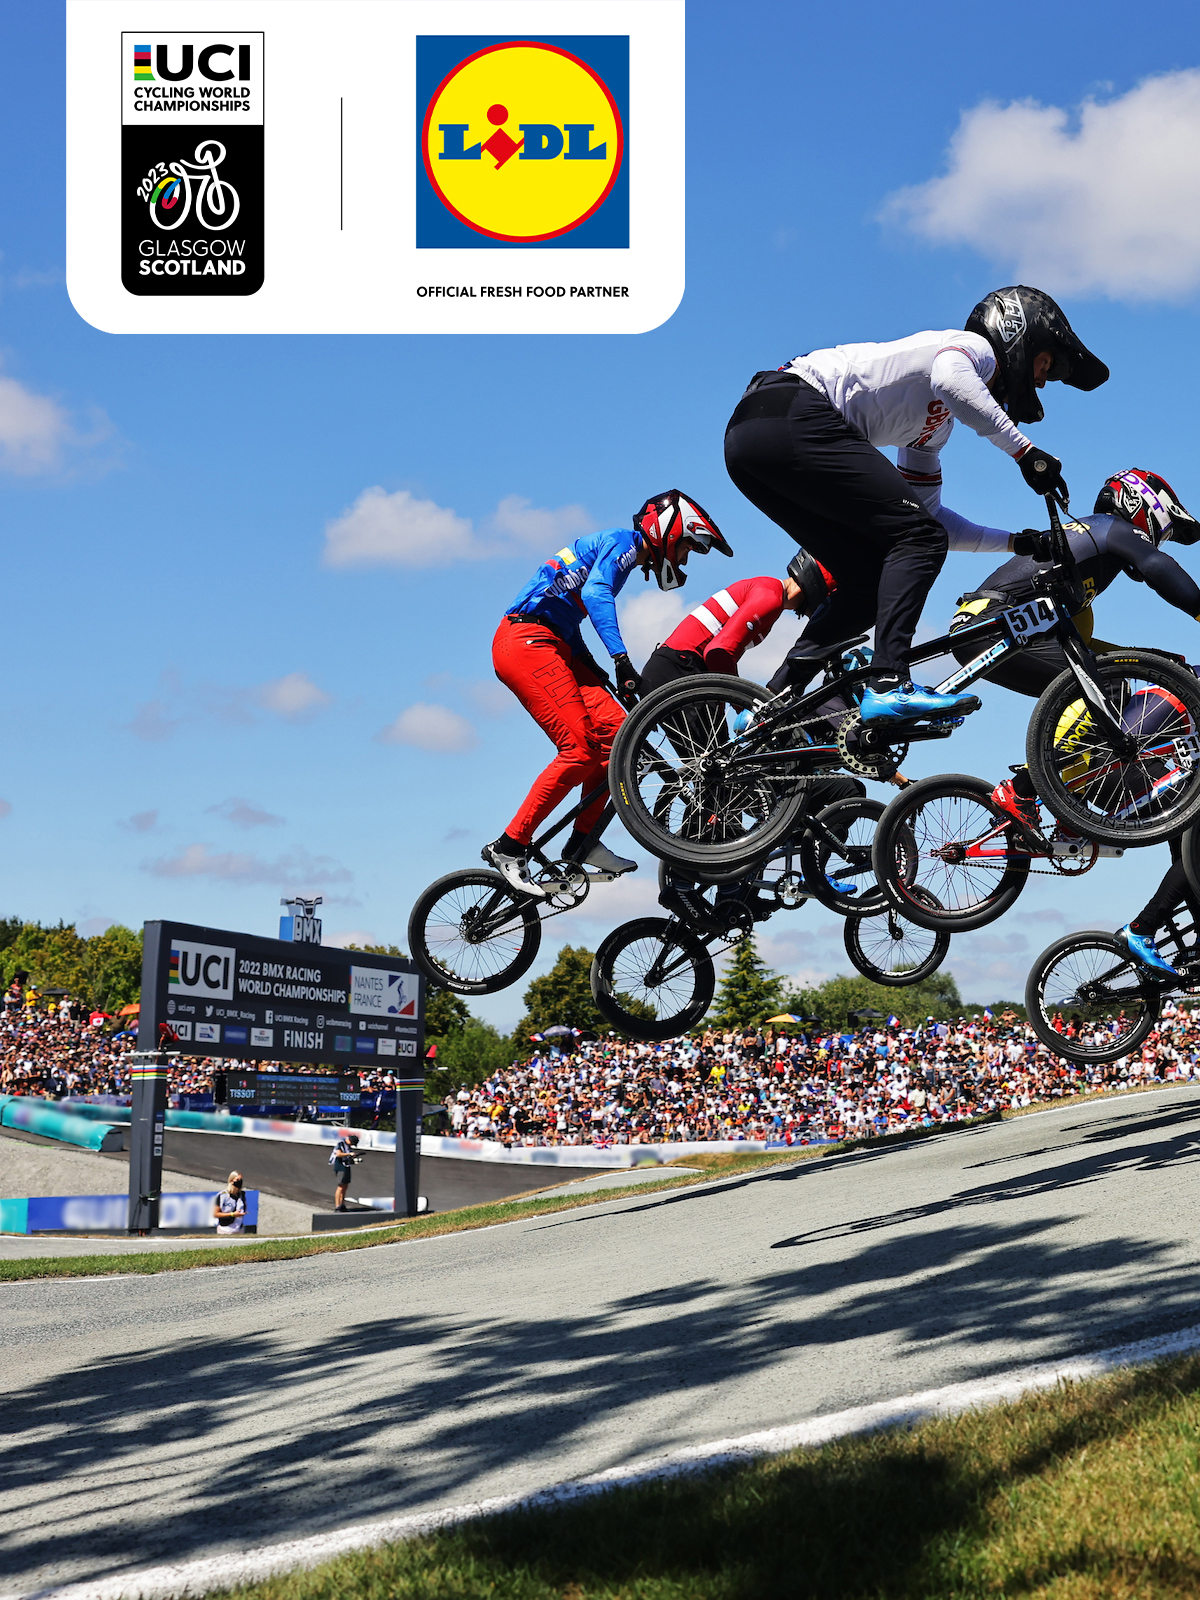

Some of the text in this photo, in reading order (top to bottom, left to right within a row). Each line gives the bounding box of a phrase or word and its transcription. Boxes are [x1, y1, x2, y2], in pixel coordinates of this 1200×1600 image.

[1007, 600, 1055, 633] 514
[532, 658, 584, 708] FLY
[1176, 735, 1200, 757] 51
[294, 916, 322, 945] BMX
[181, 951, 230, 990] UCI
[239, 960, 321, 983] 2022 BMX RACING
[238, 978, 346, 1004] WORLD CHAMPIONSHIPS
[354, 976, 384, 991] NANTES
[178, 1004, 196, 1014] uci.org
[353, 993, 382, 1008] FRANCE
[283, 1030, 324, 1050] FINISH
[401, 1043, 414, 1054] UCI
[229, 1088, 257, 1098] TISSOT
[340, 1092, 361, 1101] TISSOT
